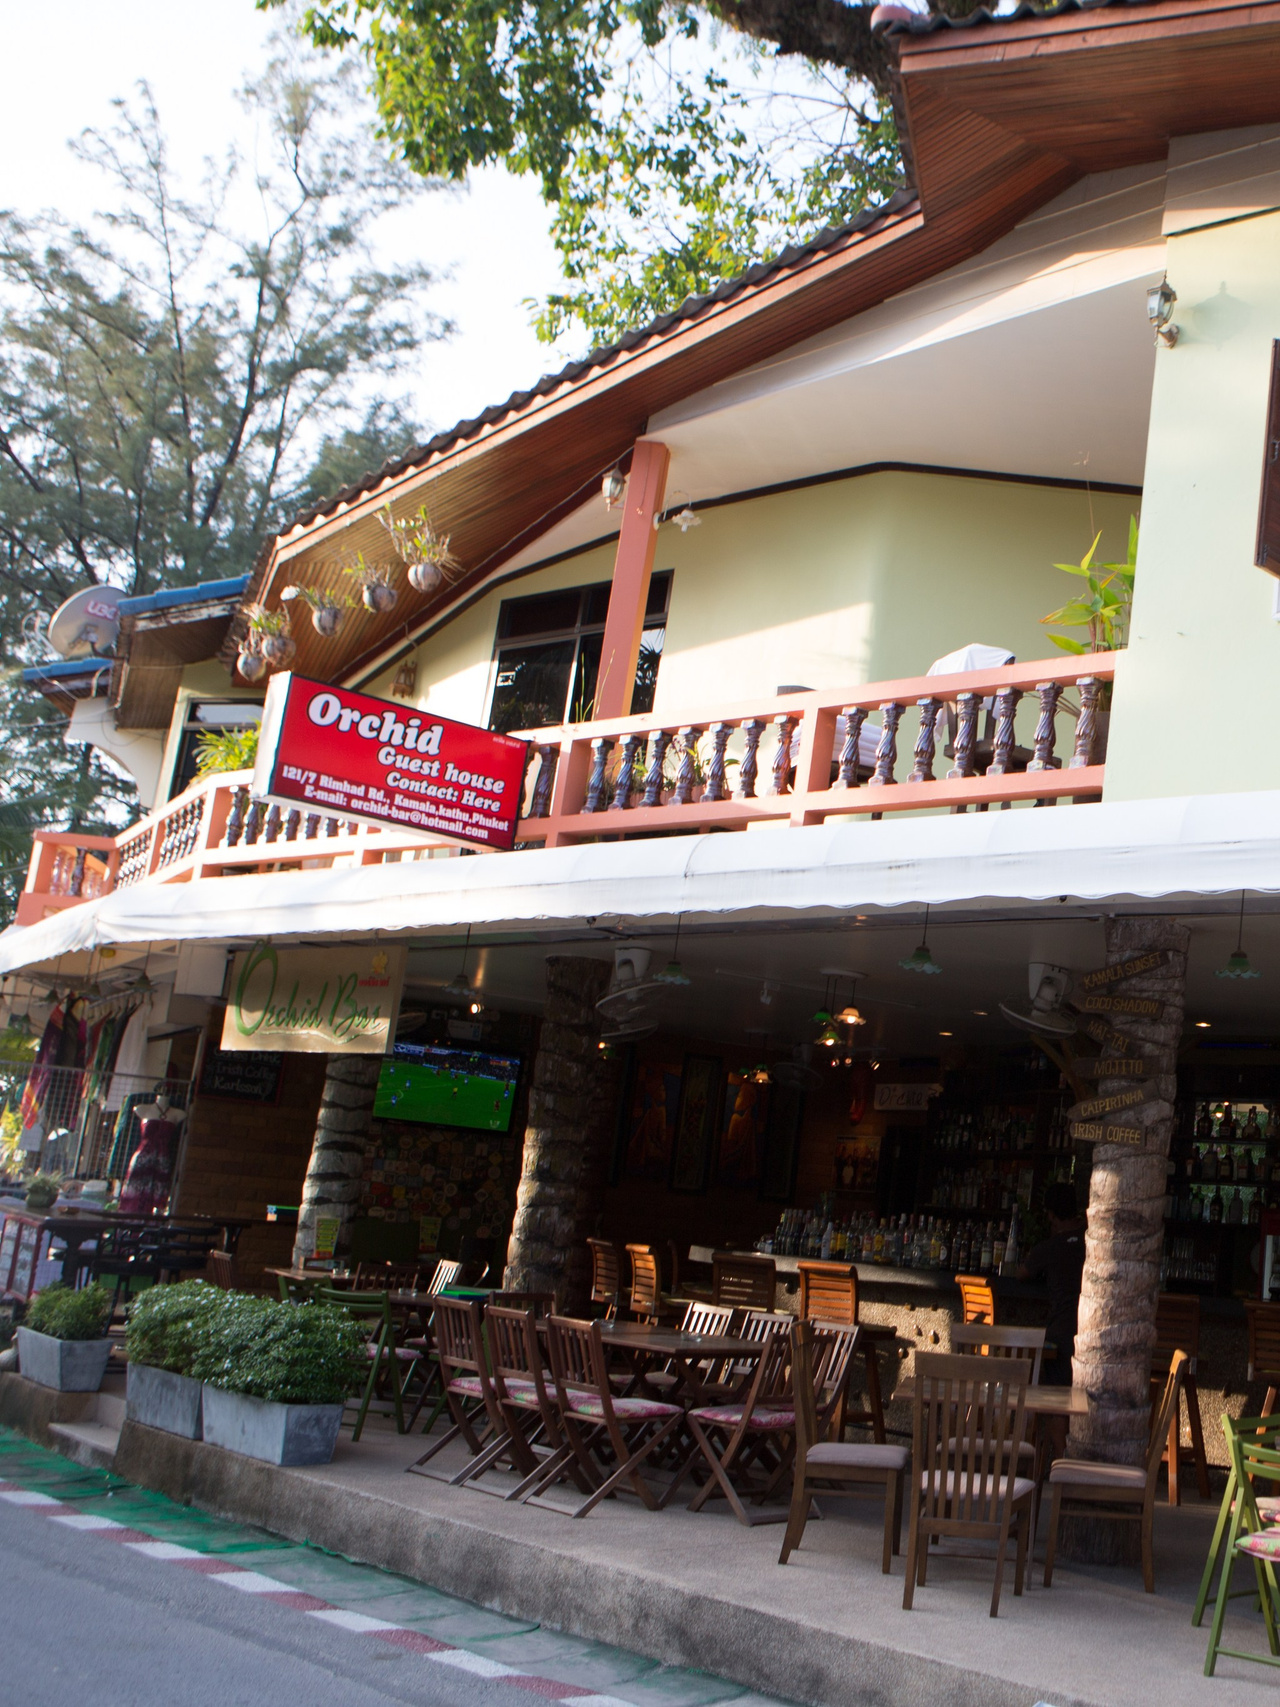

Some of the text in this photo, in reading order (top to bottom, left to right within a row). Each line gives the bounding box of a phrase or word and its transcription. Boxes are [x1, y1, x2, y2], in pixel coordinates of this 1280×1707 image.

[308, 691, 444, 755] Orchid
[282, 765, 317, 785] 121/7
[319, 774, 366, 797] Rimhad
[367, 786, 391, 804] Rd.,
[377, 746, 505, 794] Guest house
[386, 771, 501, 812] Contact: Here
[304, 784, 489, 839] E-mail: orchid-bar@hotmail.com
[235, 938, 386, 1038] Orchid Bar
[1083, 952, 1162, 990] KAMALA SUNSET
[1085, 996, 1158, 1014] COCO SHADOW
[1093, 1059, 1143, 1075] MOJITO
[1080, 1089, 1144, 1117] CAIPIRINHA
[1073, 1122, 1141, 1144] IRISH COFFEE
